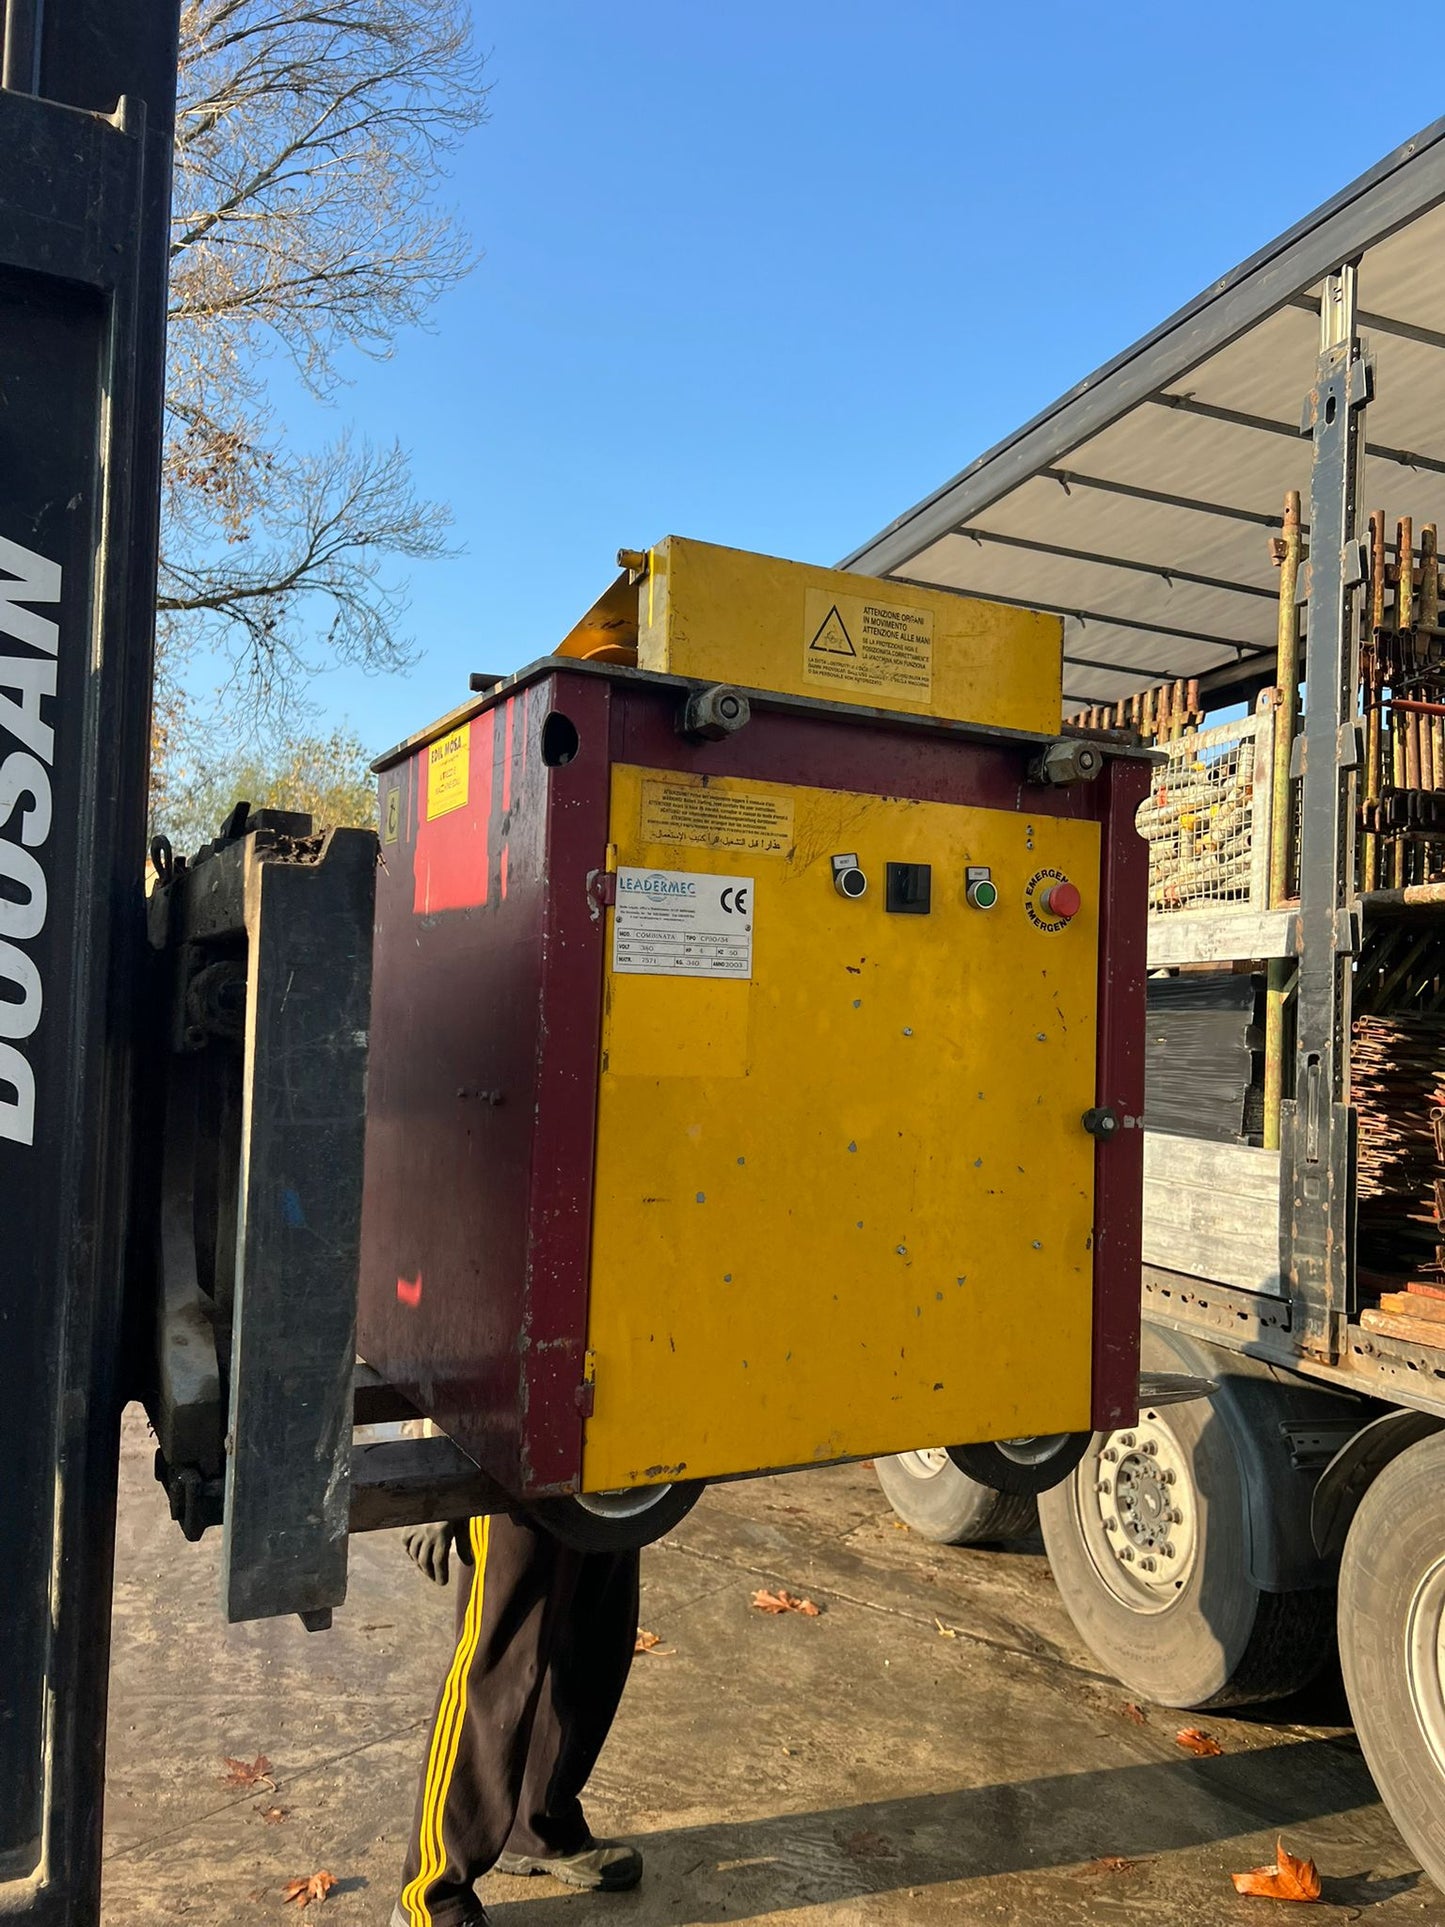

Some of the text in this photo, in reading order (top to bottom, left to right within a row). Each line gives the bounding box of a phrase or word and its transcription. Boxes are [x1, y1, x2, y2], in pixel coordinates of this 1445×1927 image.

[862, 616, 907, 631] IN MOVIMENTO
[863, 606, 924, 625] ATTENZIONE ORGANI
[863, 626, 930, 644] ATTENZIONE ALLE MANI
[619, 877, 696, 895] LEADERMEC
[1025, 869, 1069, 896] EMERGEN
[720, 887, 748, 915] CE
[1025, 901, 1072, 932] EMERGENC
[635, 931, 676, 940] COMBINATA
